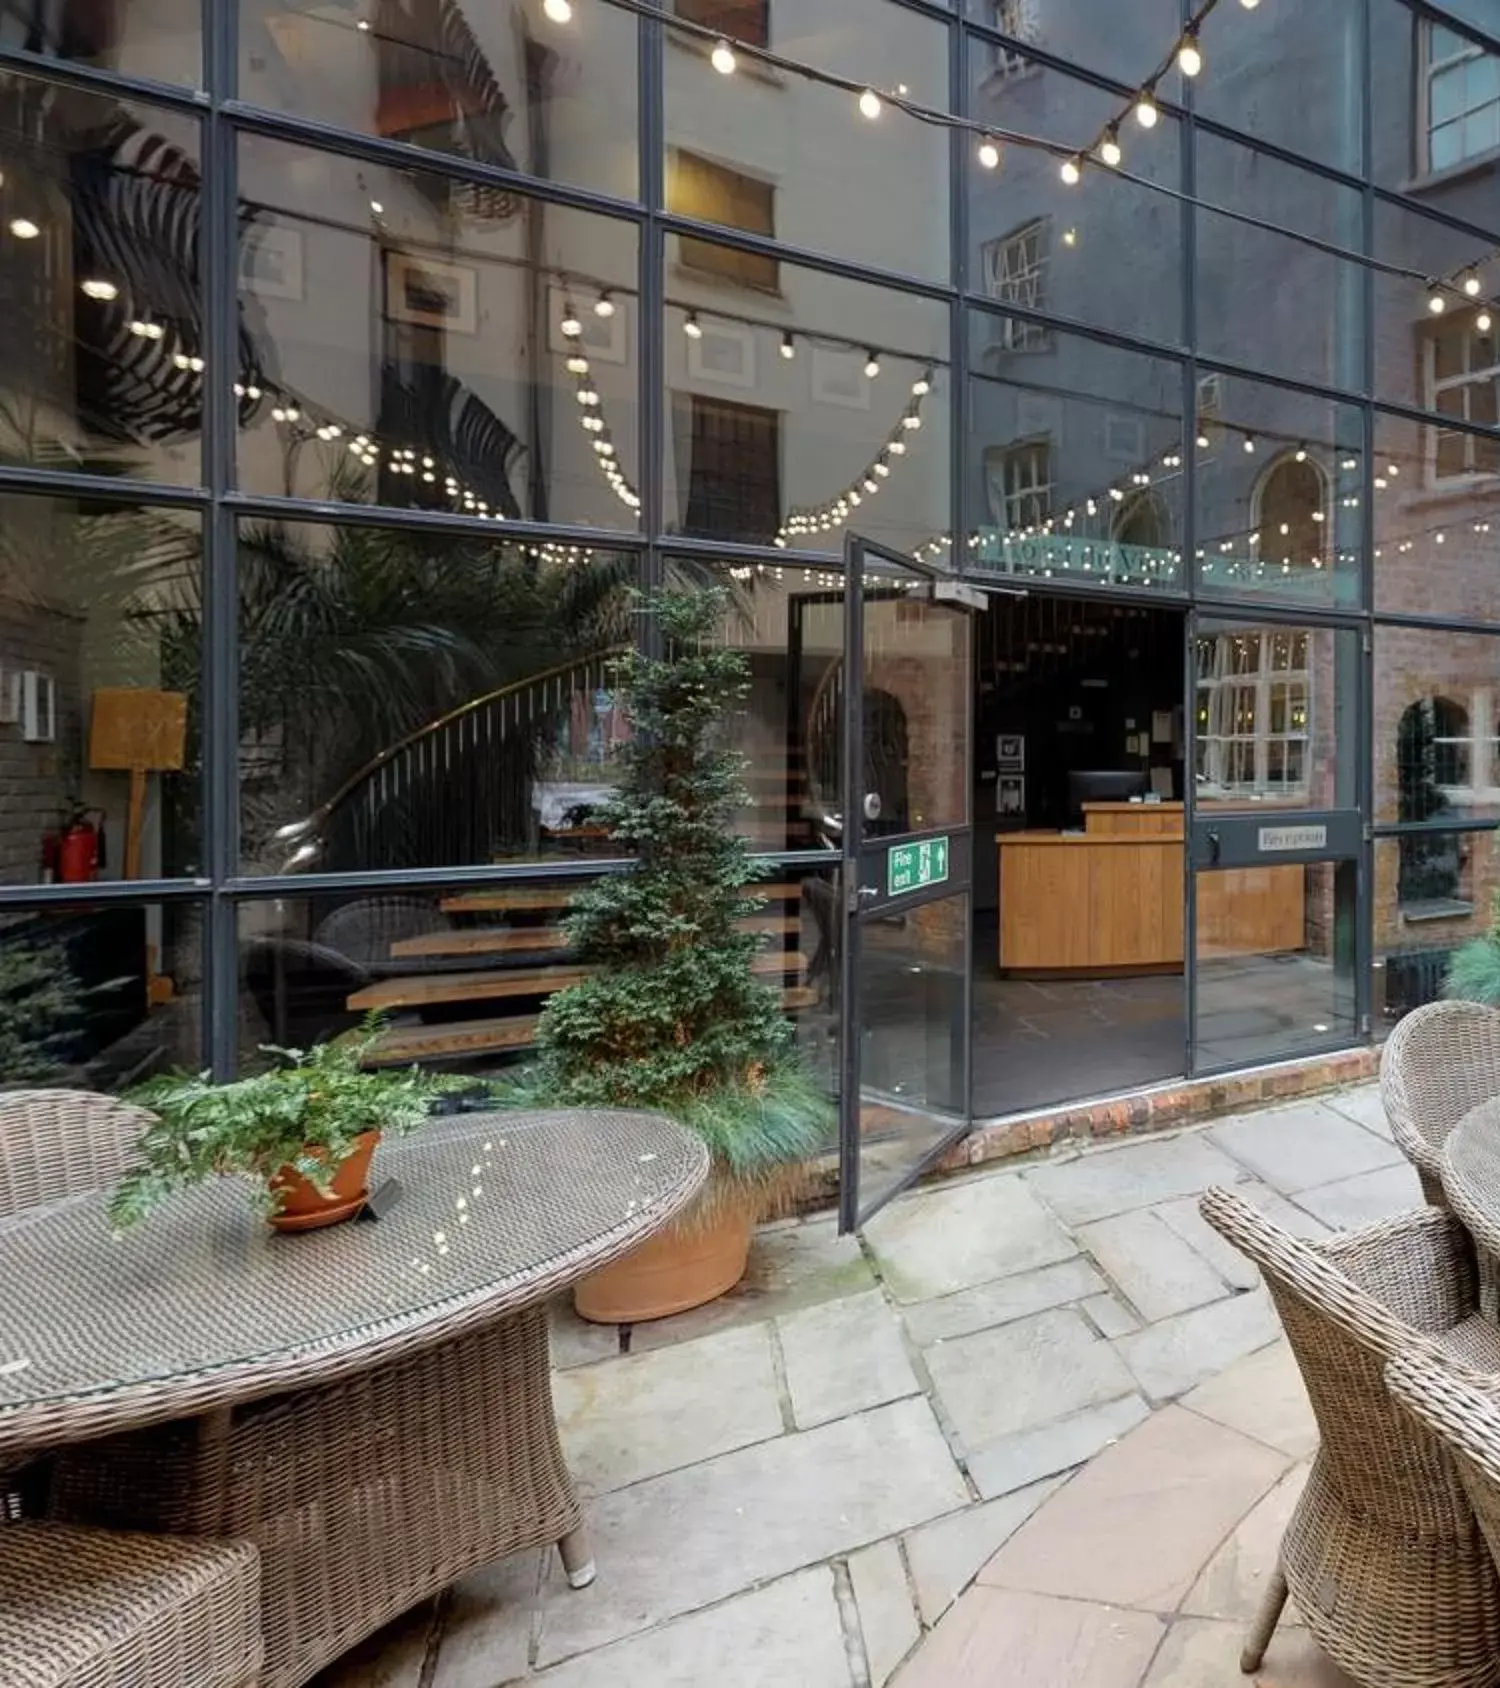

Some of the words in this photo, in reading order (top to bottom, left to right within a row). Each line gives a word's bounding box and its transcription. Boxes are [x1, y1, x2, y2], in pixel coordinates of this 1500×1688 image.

[1263, 831, 1323, 846] Reception
[894, 850, 912, 867] Fire
[894, 870, 911, 887] exit
